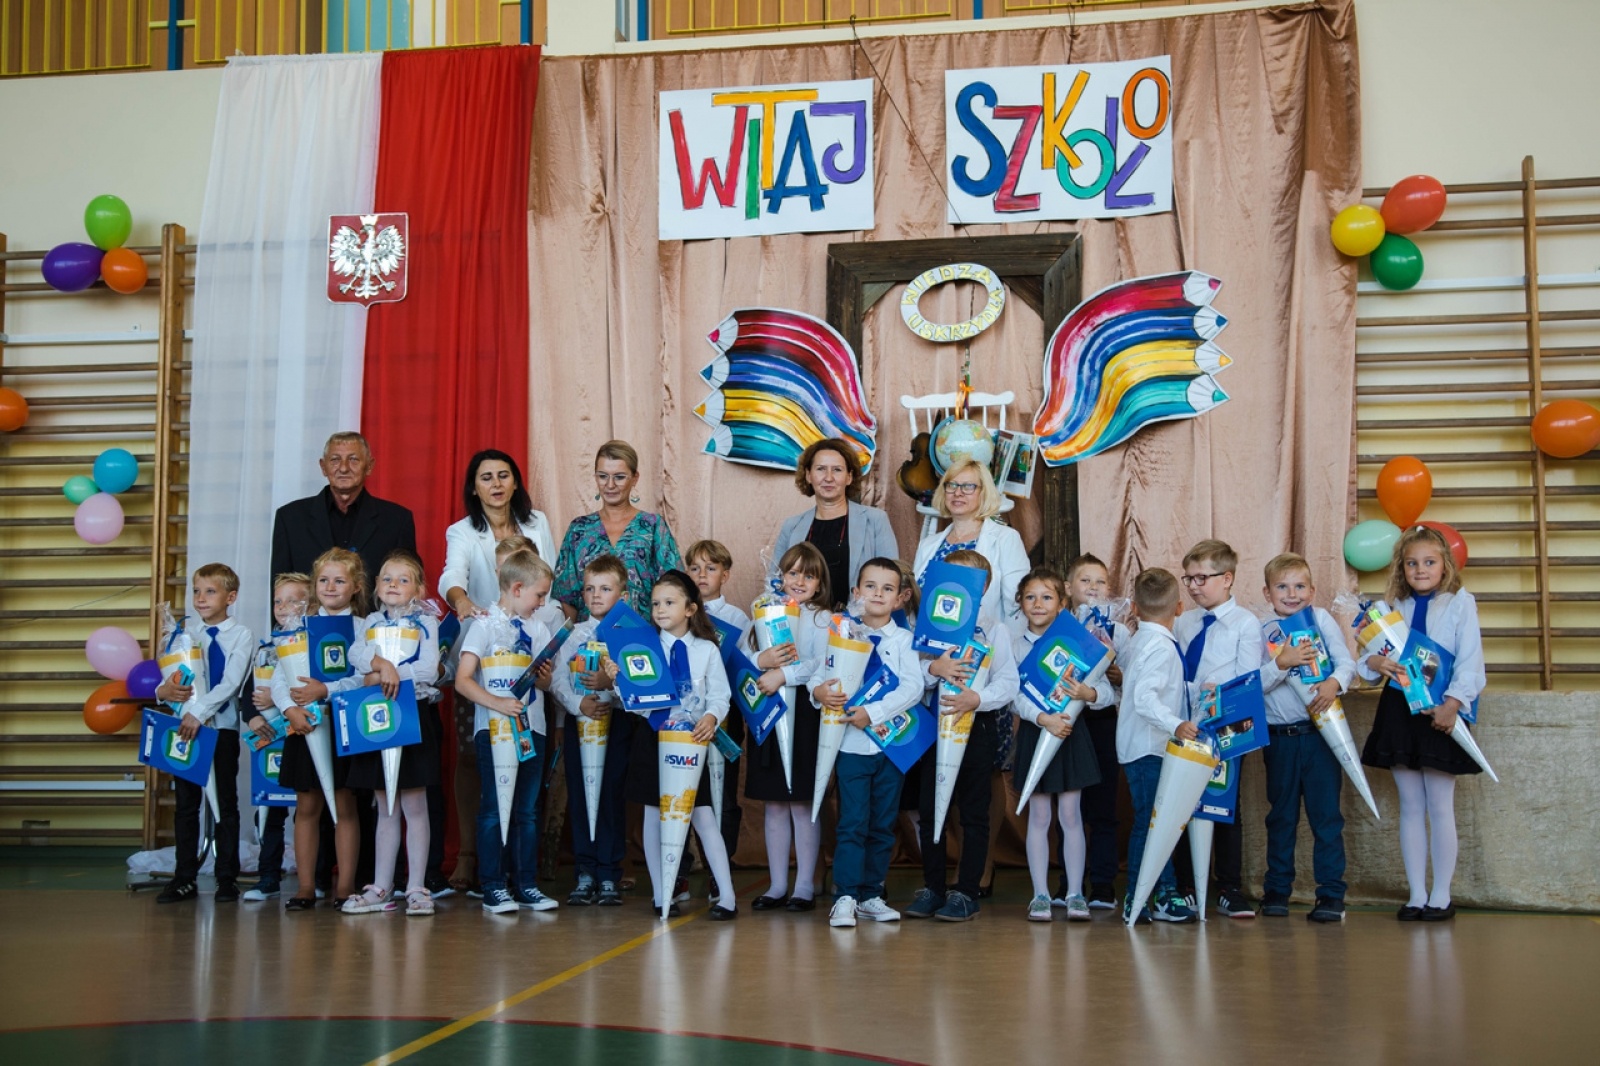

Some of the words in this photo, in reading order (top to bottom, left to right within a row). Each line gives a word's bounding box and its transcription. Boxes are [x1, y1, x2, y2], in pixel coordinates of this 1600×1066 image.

[668, 89, 867, 220] WITAJ
[951, 67, 1171, 213] SZKOŁO
[901, 264, 993, 306] WIEDZA
